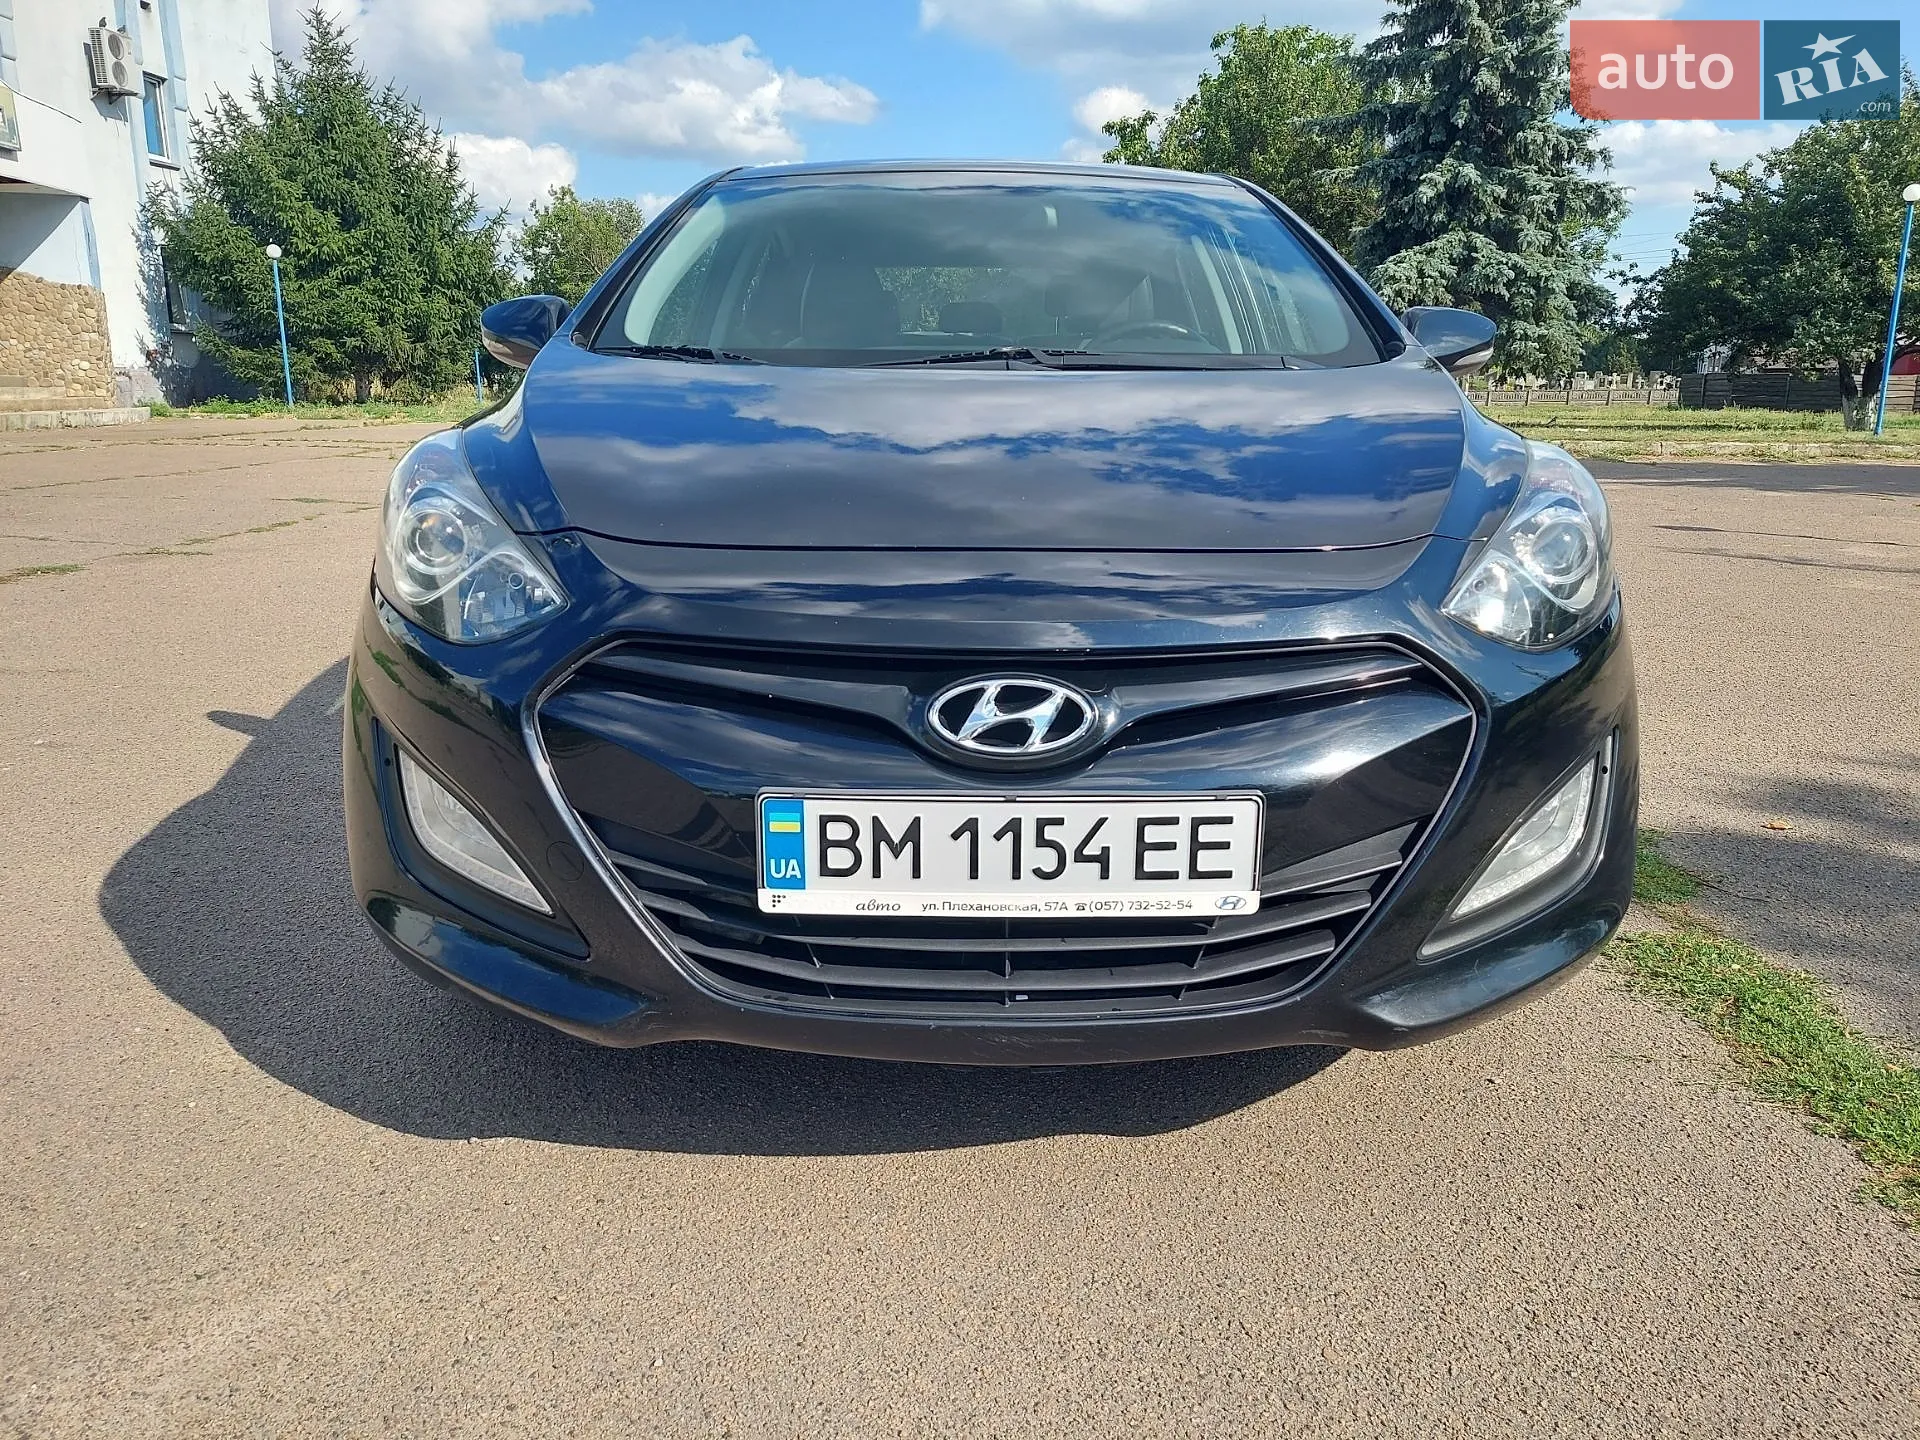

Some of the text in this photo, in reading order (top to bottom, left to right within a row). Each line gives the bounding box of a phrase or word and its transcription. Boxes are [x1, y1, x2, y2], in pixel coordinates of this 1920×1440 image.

[819, 815, 1234, 880] BM 1154 EE
[770, 859, 801, 879] UA
[856, 899, 901, 911] авто
[922, 902, 939, 911] ул.
[942, 902, 1041, 912] Плехановская,
[1044, 901, 1068, 911] 57А
[1089, 901, 1124, 913] (057)
[1128, 900, 1193, 910] 732-52-54
